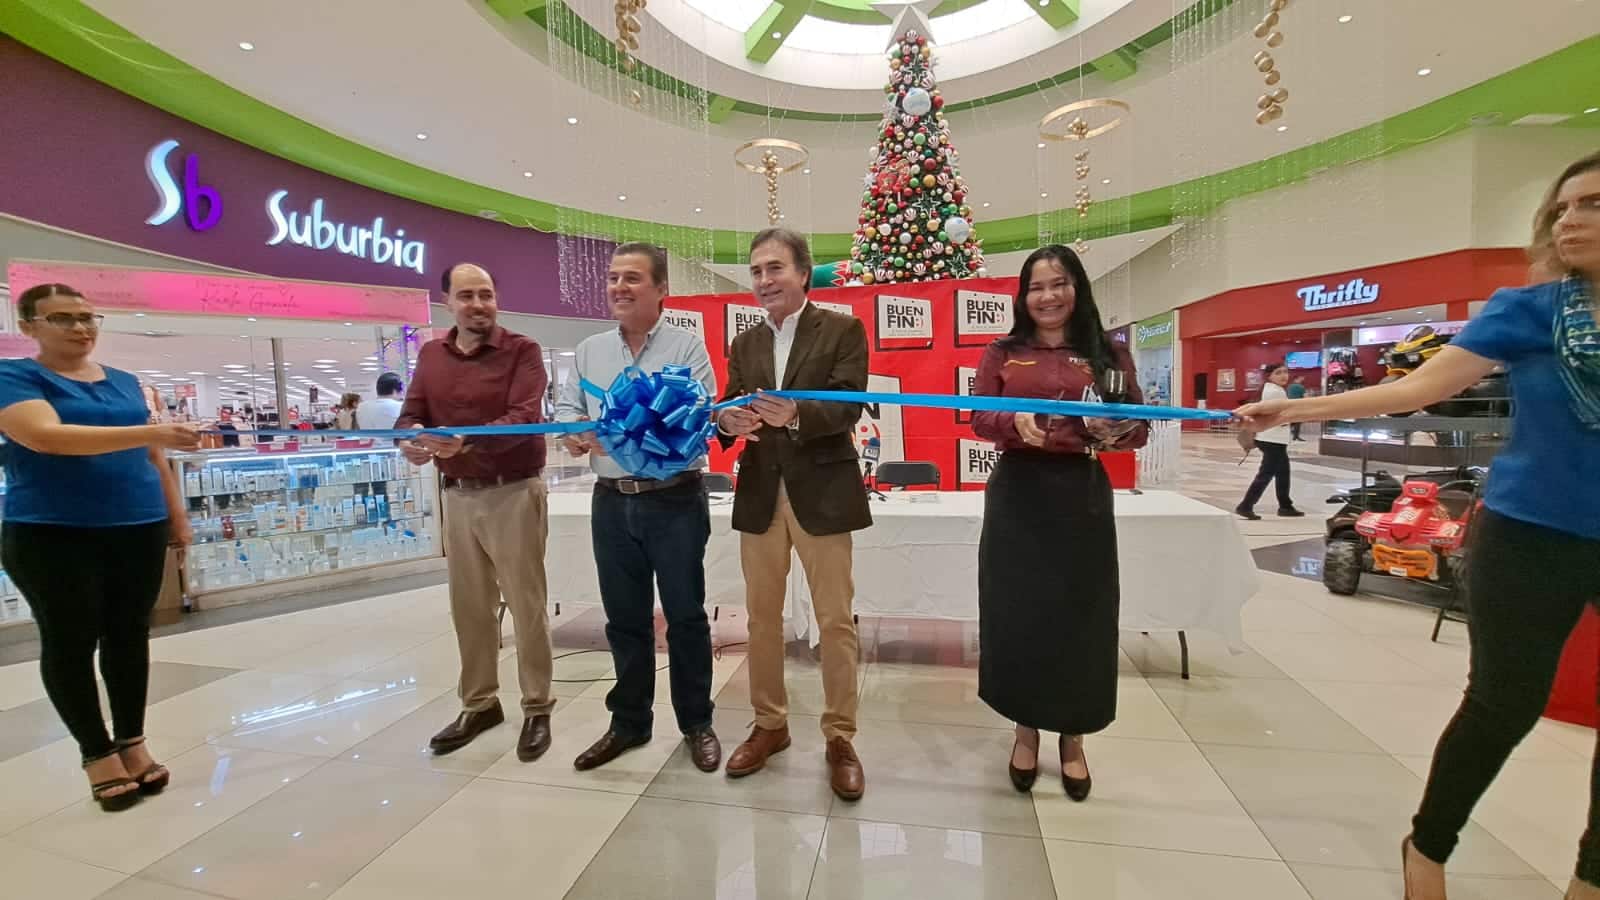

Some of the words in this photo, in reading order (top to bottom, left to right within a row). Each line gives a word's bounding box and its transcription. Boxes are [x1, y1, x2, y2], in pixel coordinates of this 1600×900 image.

[145, 139, 223, 231] Sb
[265, 189, 425, 274] Suburbia
[887, 303, 924, 316] BUEN
[967, 299, 1005, 312] BUEN
[1296, 277, 1380, 311] Thrifty
